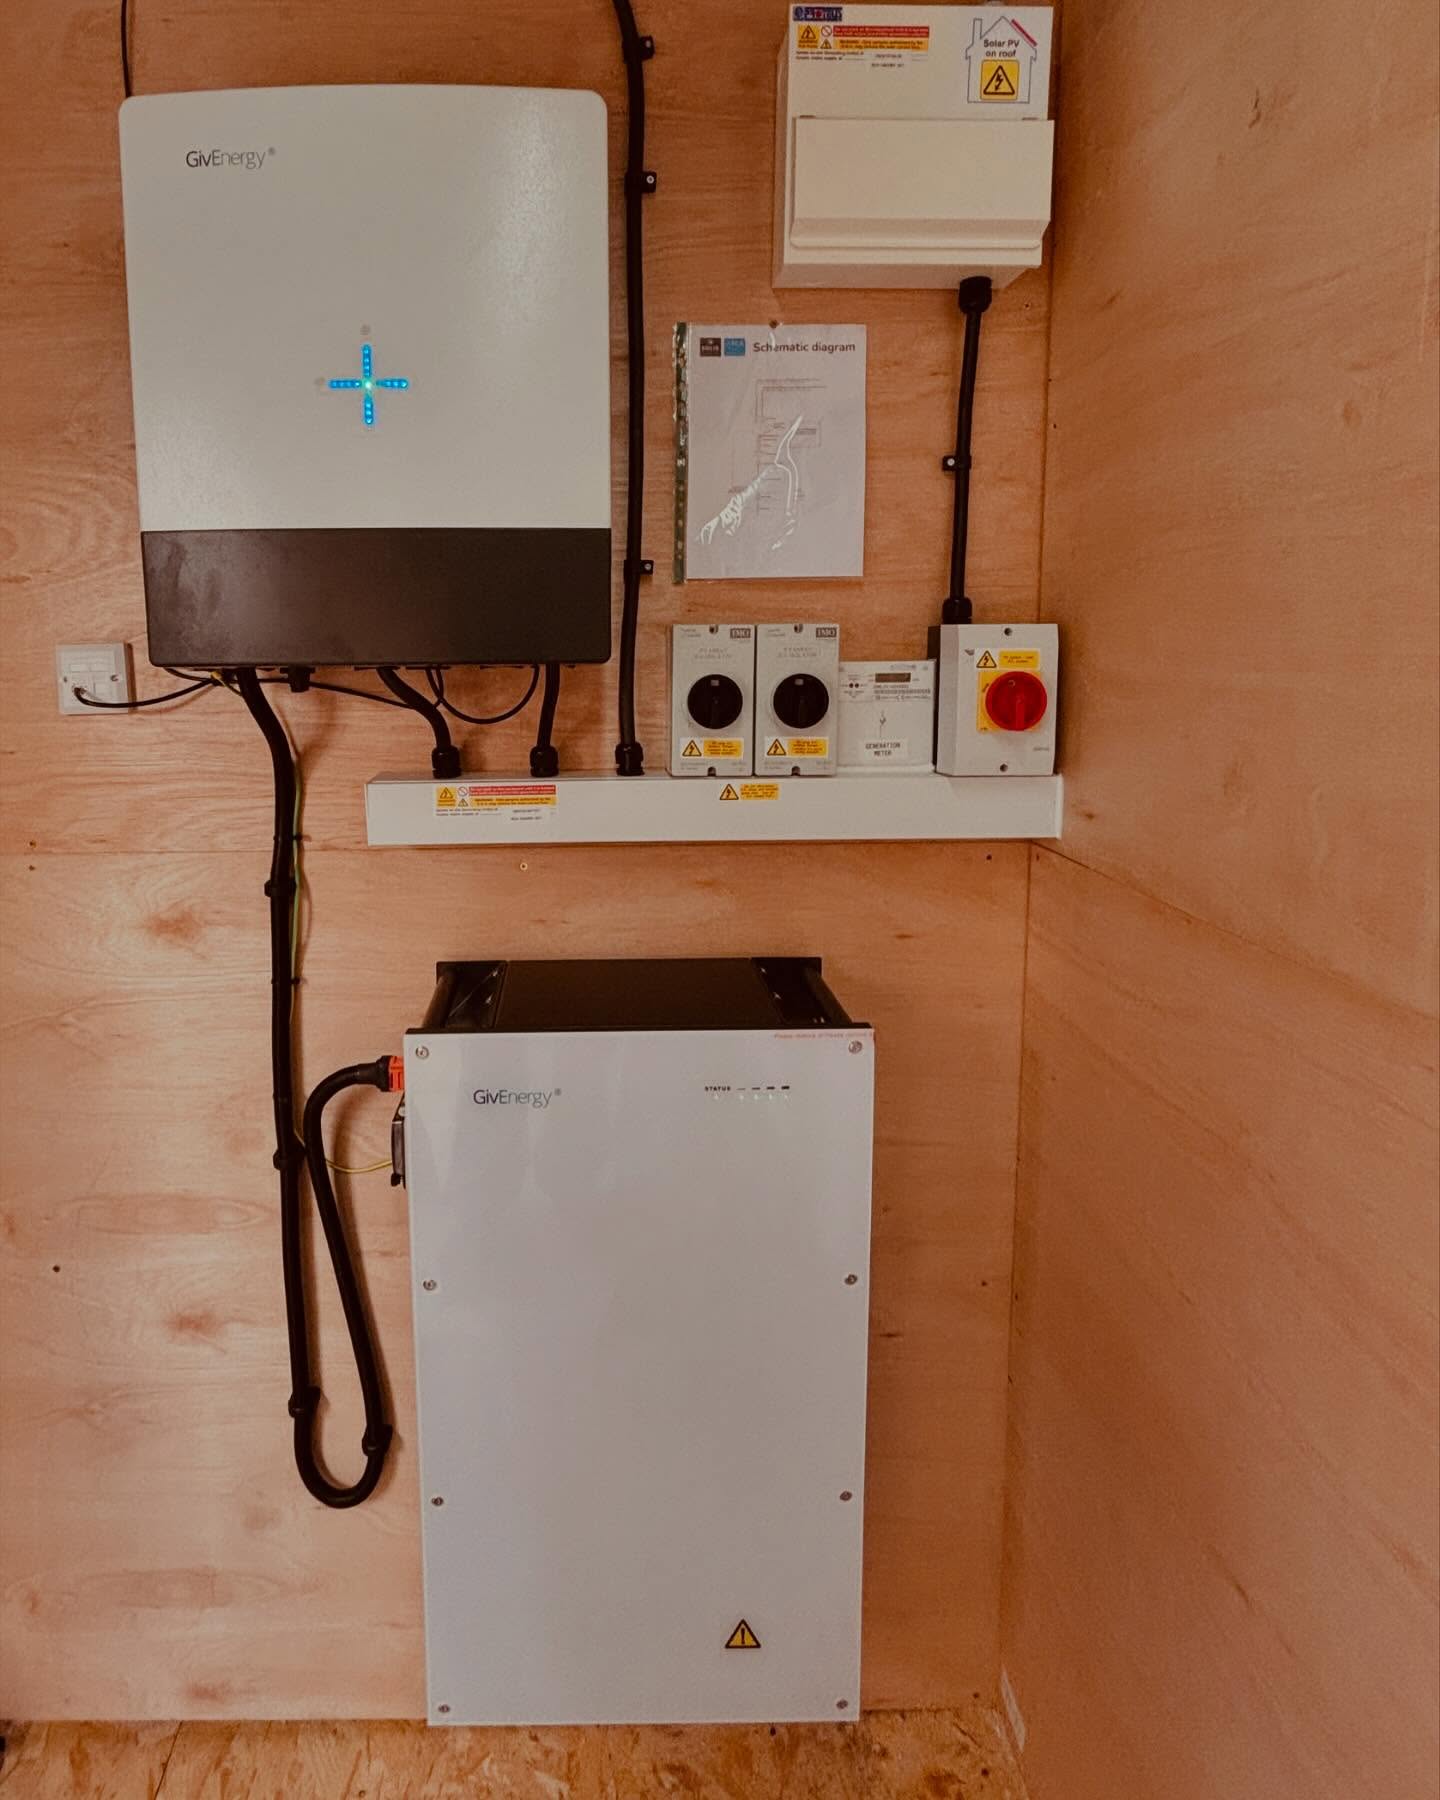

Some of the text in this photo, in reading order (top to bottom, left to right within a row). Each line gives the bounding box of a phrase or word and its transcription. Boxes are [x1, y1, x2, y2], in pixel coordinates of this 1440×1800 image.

[984, 40, 1020, 48] Solar PV
[186, 149, 266, 170] GivEnergy
[753, 341, 809, 353] Schematic
[812, 341, 856, 354] diagram
[817, 628, 836, 638] IMO
[865, 742, 901, 750] GENERATION
[472, 1088, 552, 1109] GivEnergy
